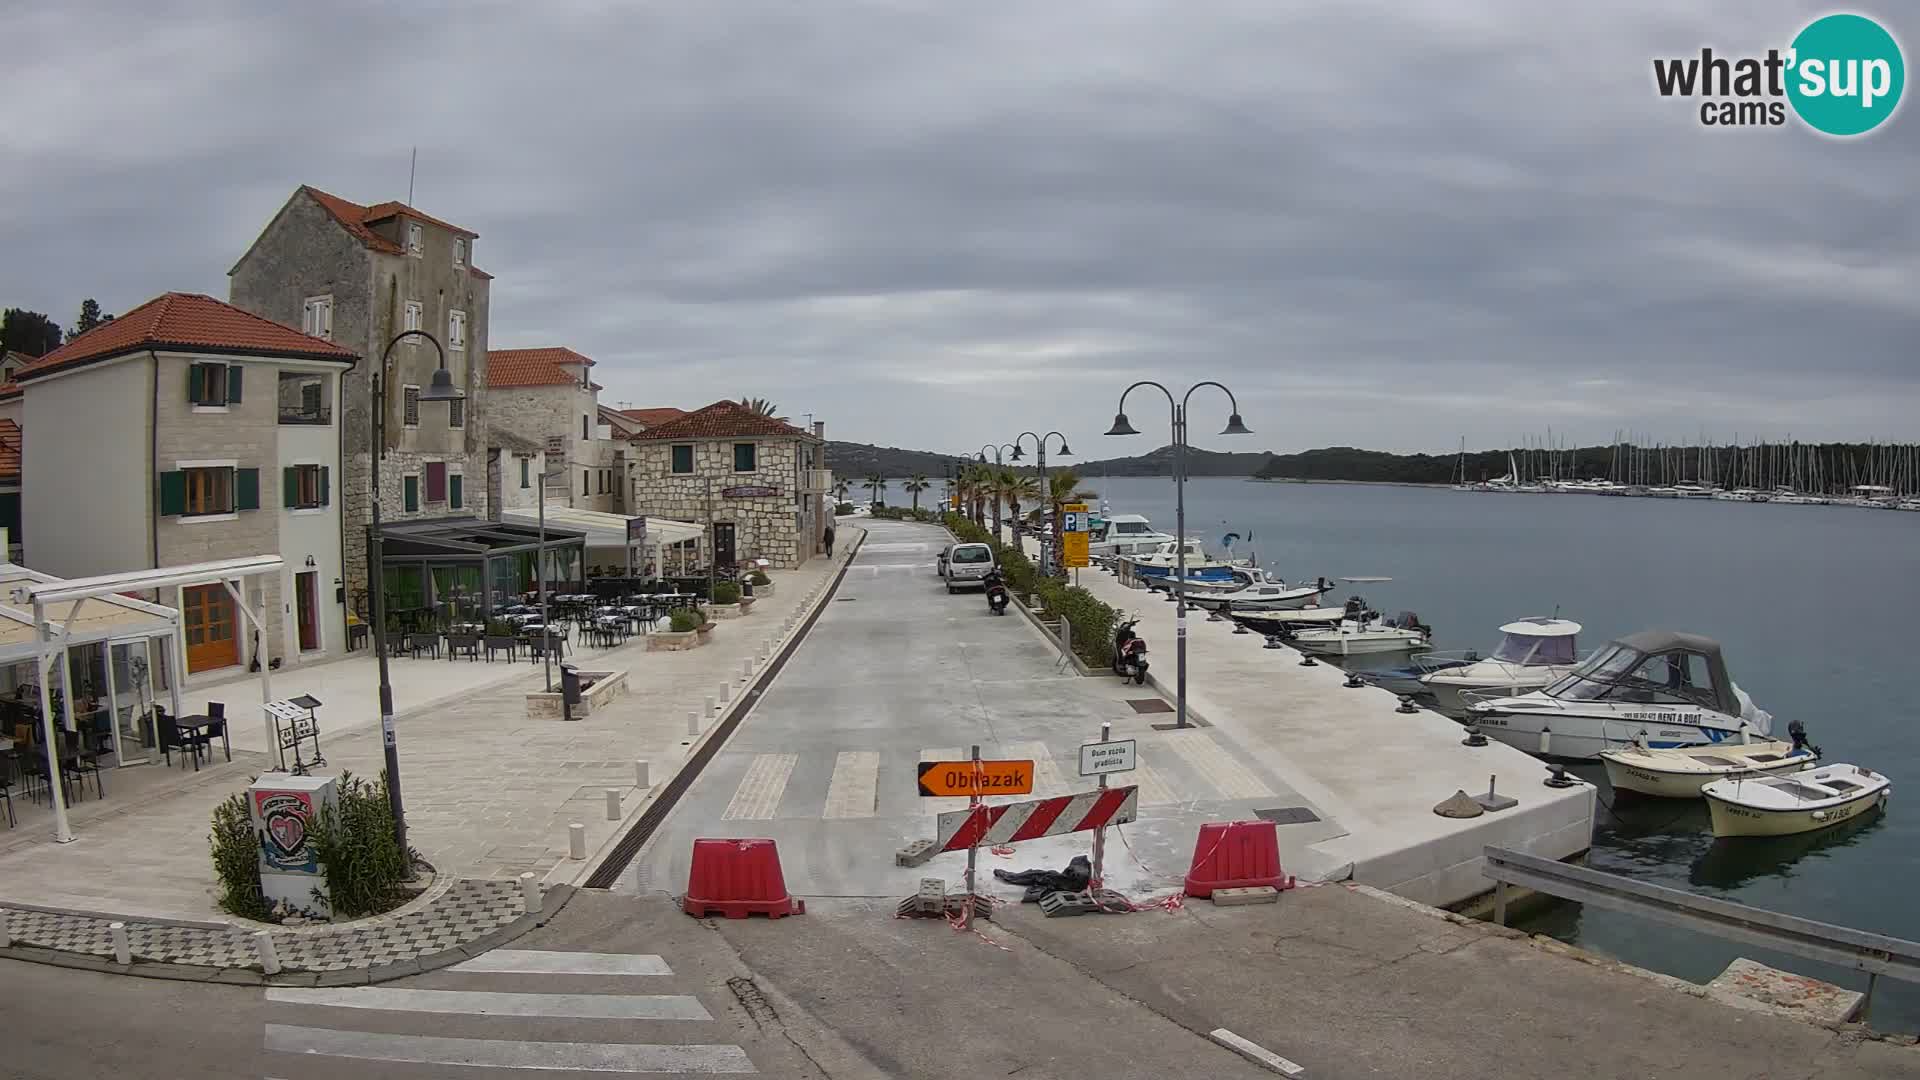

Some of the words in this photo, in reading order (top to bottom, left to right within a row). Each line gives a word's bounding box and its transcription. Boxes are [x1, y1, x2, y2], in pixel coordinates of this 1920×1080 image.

[1065, 514, 1076, 530] P
[1657, 713, 1677, 722] RENT
[1684, 713, 1702, 724] BOAT
[945, 769, 1025, 789] Obilazak
